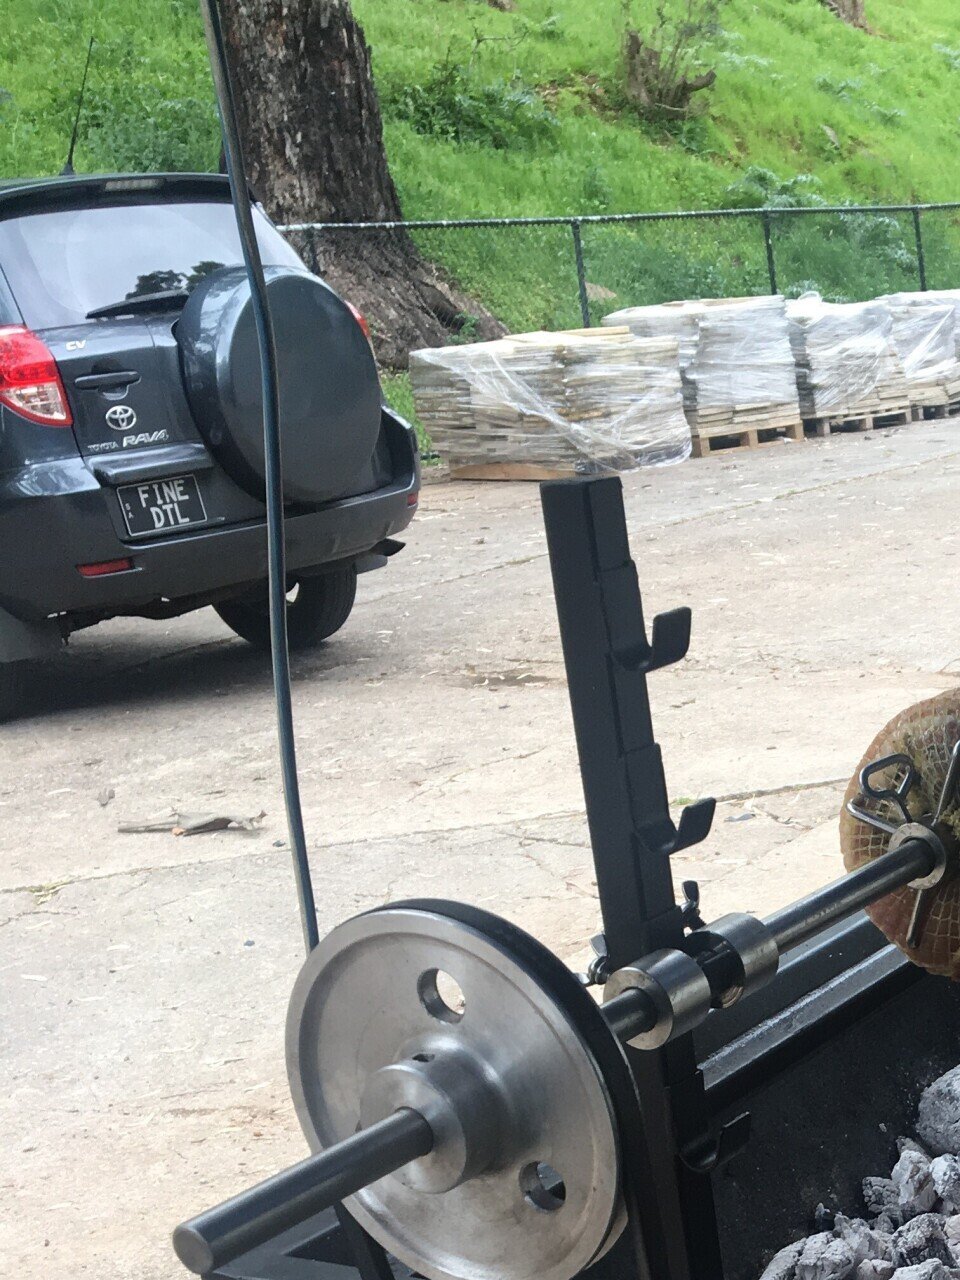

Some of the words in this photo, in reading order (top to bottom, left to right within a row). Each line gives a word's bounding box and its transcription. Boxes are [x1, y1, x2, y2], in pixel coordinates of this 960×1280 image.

[65, 339, 86, 351] CV
[87, 441, 119, 452] TOYOTA
[122, 429, 169, 447] RAV4
[137, 479, 190, 508] FINE
[149, 502, 190, 529] DTL
